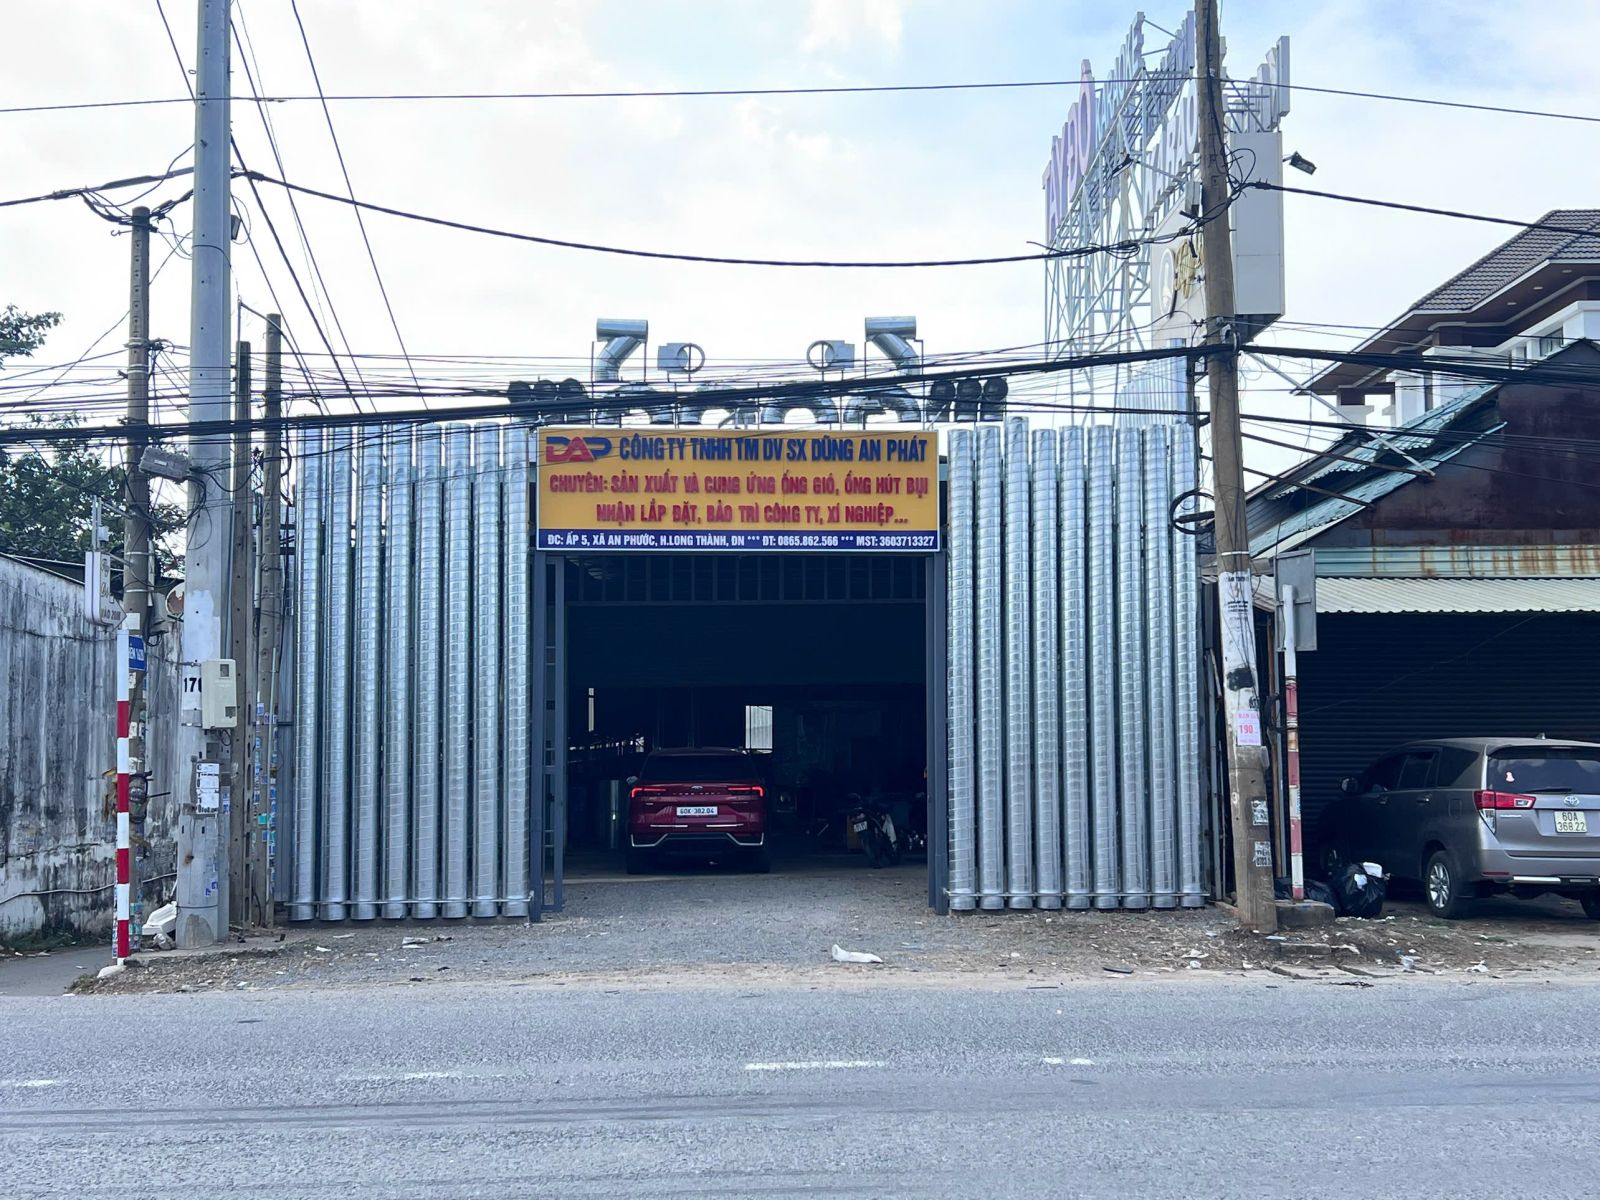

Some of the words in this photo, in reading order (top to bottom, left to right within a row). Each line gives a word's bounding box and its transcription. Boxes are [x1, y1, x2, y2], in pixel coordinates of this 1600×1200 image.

[619, 433, 665, 461] CÔNG
[666, 437, 686, 461] TY
[690, 437, 732, 461] TNHH
[735, 438, 759, 461] TM
[762, 438, 784, 461] DV
[786, 438, 807, 461] SX
[858, 439, 882, 462] AN
[887, 435, 928, 462] PHÁT
[549, 471, 608, 493] CHUYÊN:
[610, 469, 639, 493] SẢN
[644, 468, 678, 493] XUẤT
[683, 472, 699, 493] VÀ
[704, 475, 740, 494] CUNG
[746, 471, 776, 494] ỨNG
[781, 469, 808, 494] ỐNG
[813, 473, 839, 496] GIÓ,
[844, 470, 871, 494] ỐNG
[876, 473, 901, 494] HÚT
[906, 477, 928, 499] BỤI
[596, 501, 635, 526] NHẬN
[706, 499, 733, 522] BẢO
[738, 502, 759, 523] TRÌ
[763, 502, 801, 523] CÔNG
[805, 505, 823, 525] TY,
[827, 502, 840, 523] XÍ
[547, 534, 564, 545] ĐC:
[565, 531, 580, 545] ẤP
[581, 534, 590, 547] 5,
[592, 533, 606, 546] XÃ
[607, 534, 622, 546] AN
[623, 533, 658, 547] PHƯỚC,
[660, 535, 694, 547] H.LONG
[695, 532, 730, 547] THÀNH,
[731, 535, 745, 547] ĐN
[762, 535, 776, 547] ĐT:
[777, 535, 839, 547] 0865.862.566
[856, 536, 878, 547] MST:
[879, 535, 935, 547] 3603713327
[1561, 812, 1578, 822] 60A
